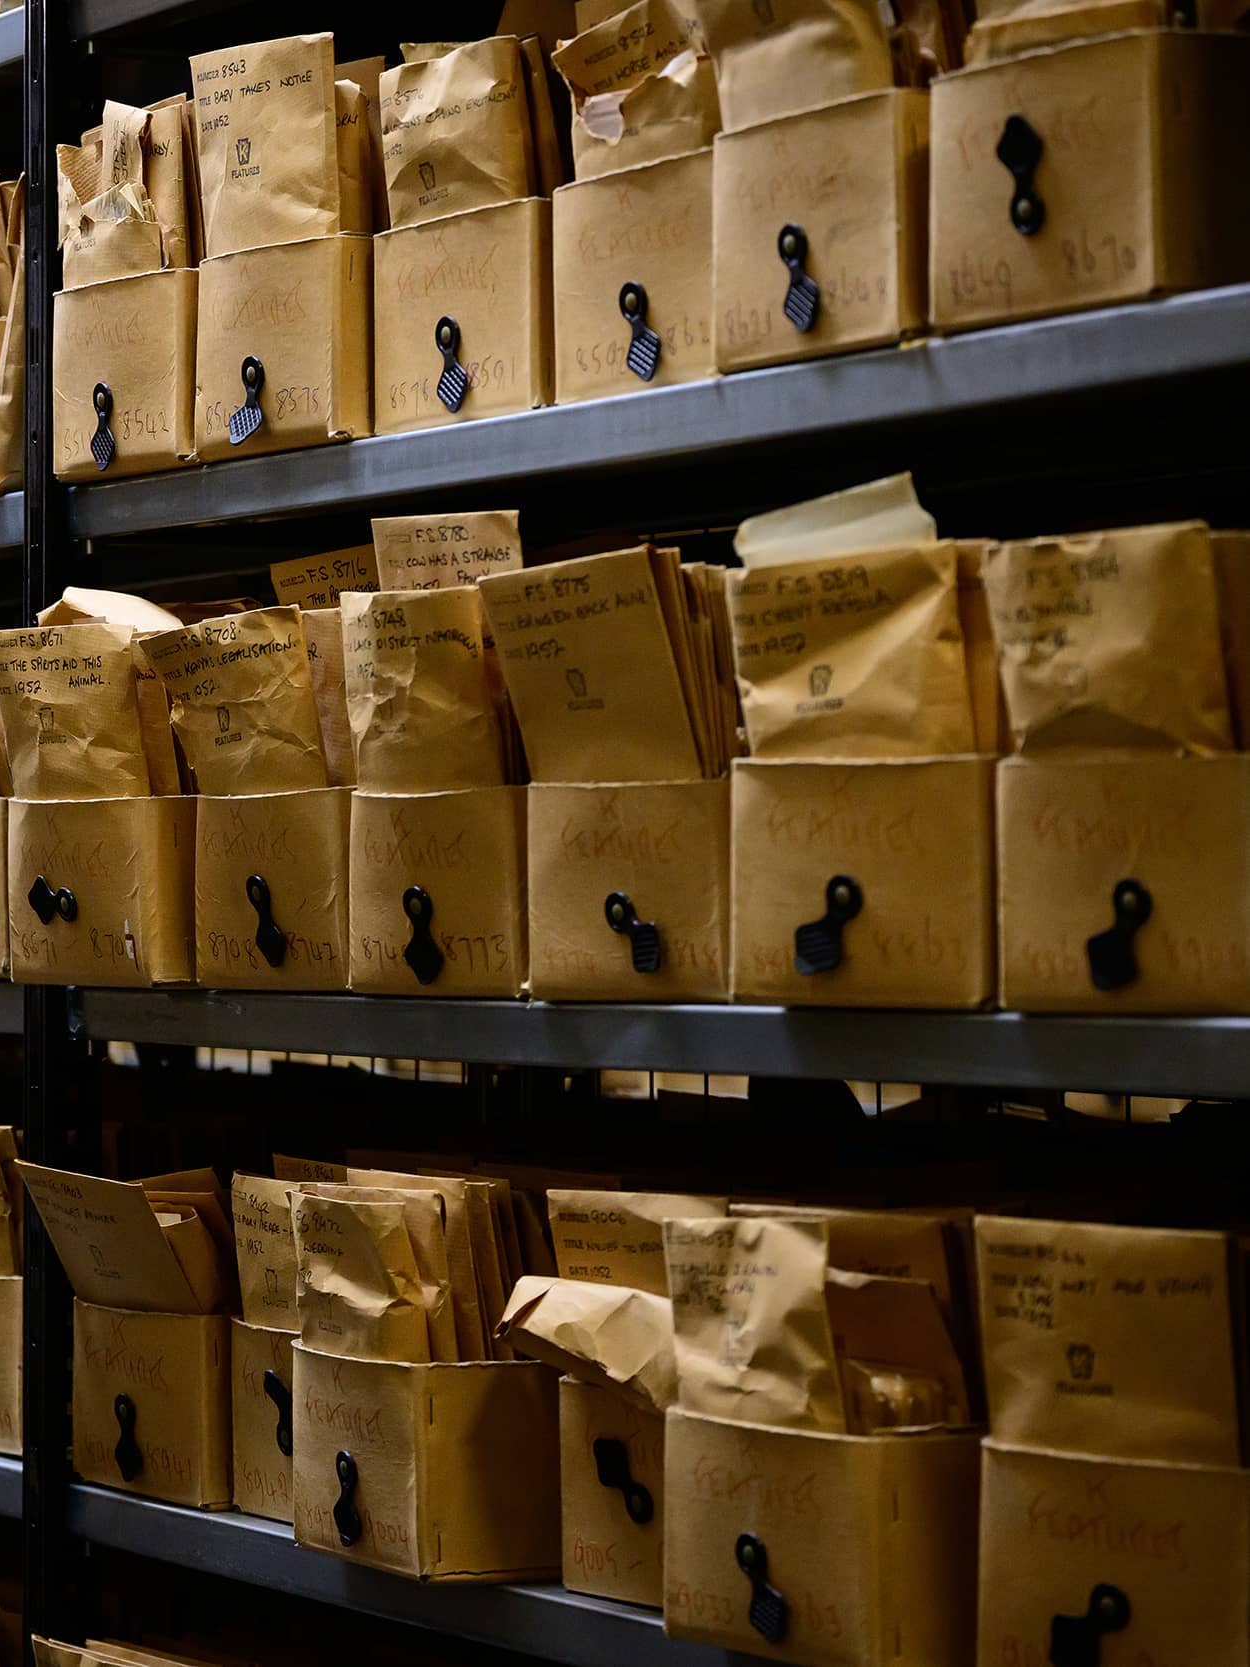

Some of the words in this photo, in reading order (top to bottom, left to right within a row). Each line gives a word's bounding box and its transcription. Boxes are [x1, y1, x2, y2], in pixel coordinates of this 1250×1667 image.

[221, 58, 247, 79] 8543
[240, 79, 271, 97] TAKES
[279, 69, 314, 89] NOTICE
[123, 408, 170, 441] 8542
[429, 553, 448, 567] HAS
[451, 553, 459, 565] A
[306, 590, 327, 606] THE
[10, 657, 27, 672] THE
[62, 657, 78, 670] AID
[82, 655, 102, 669] THIS
